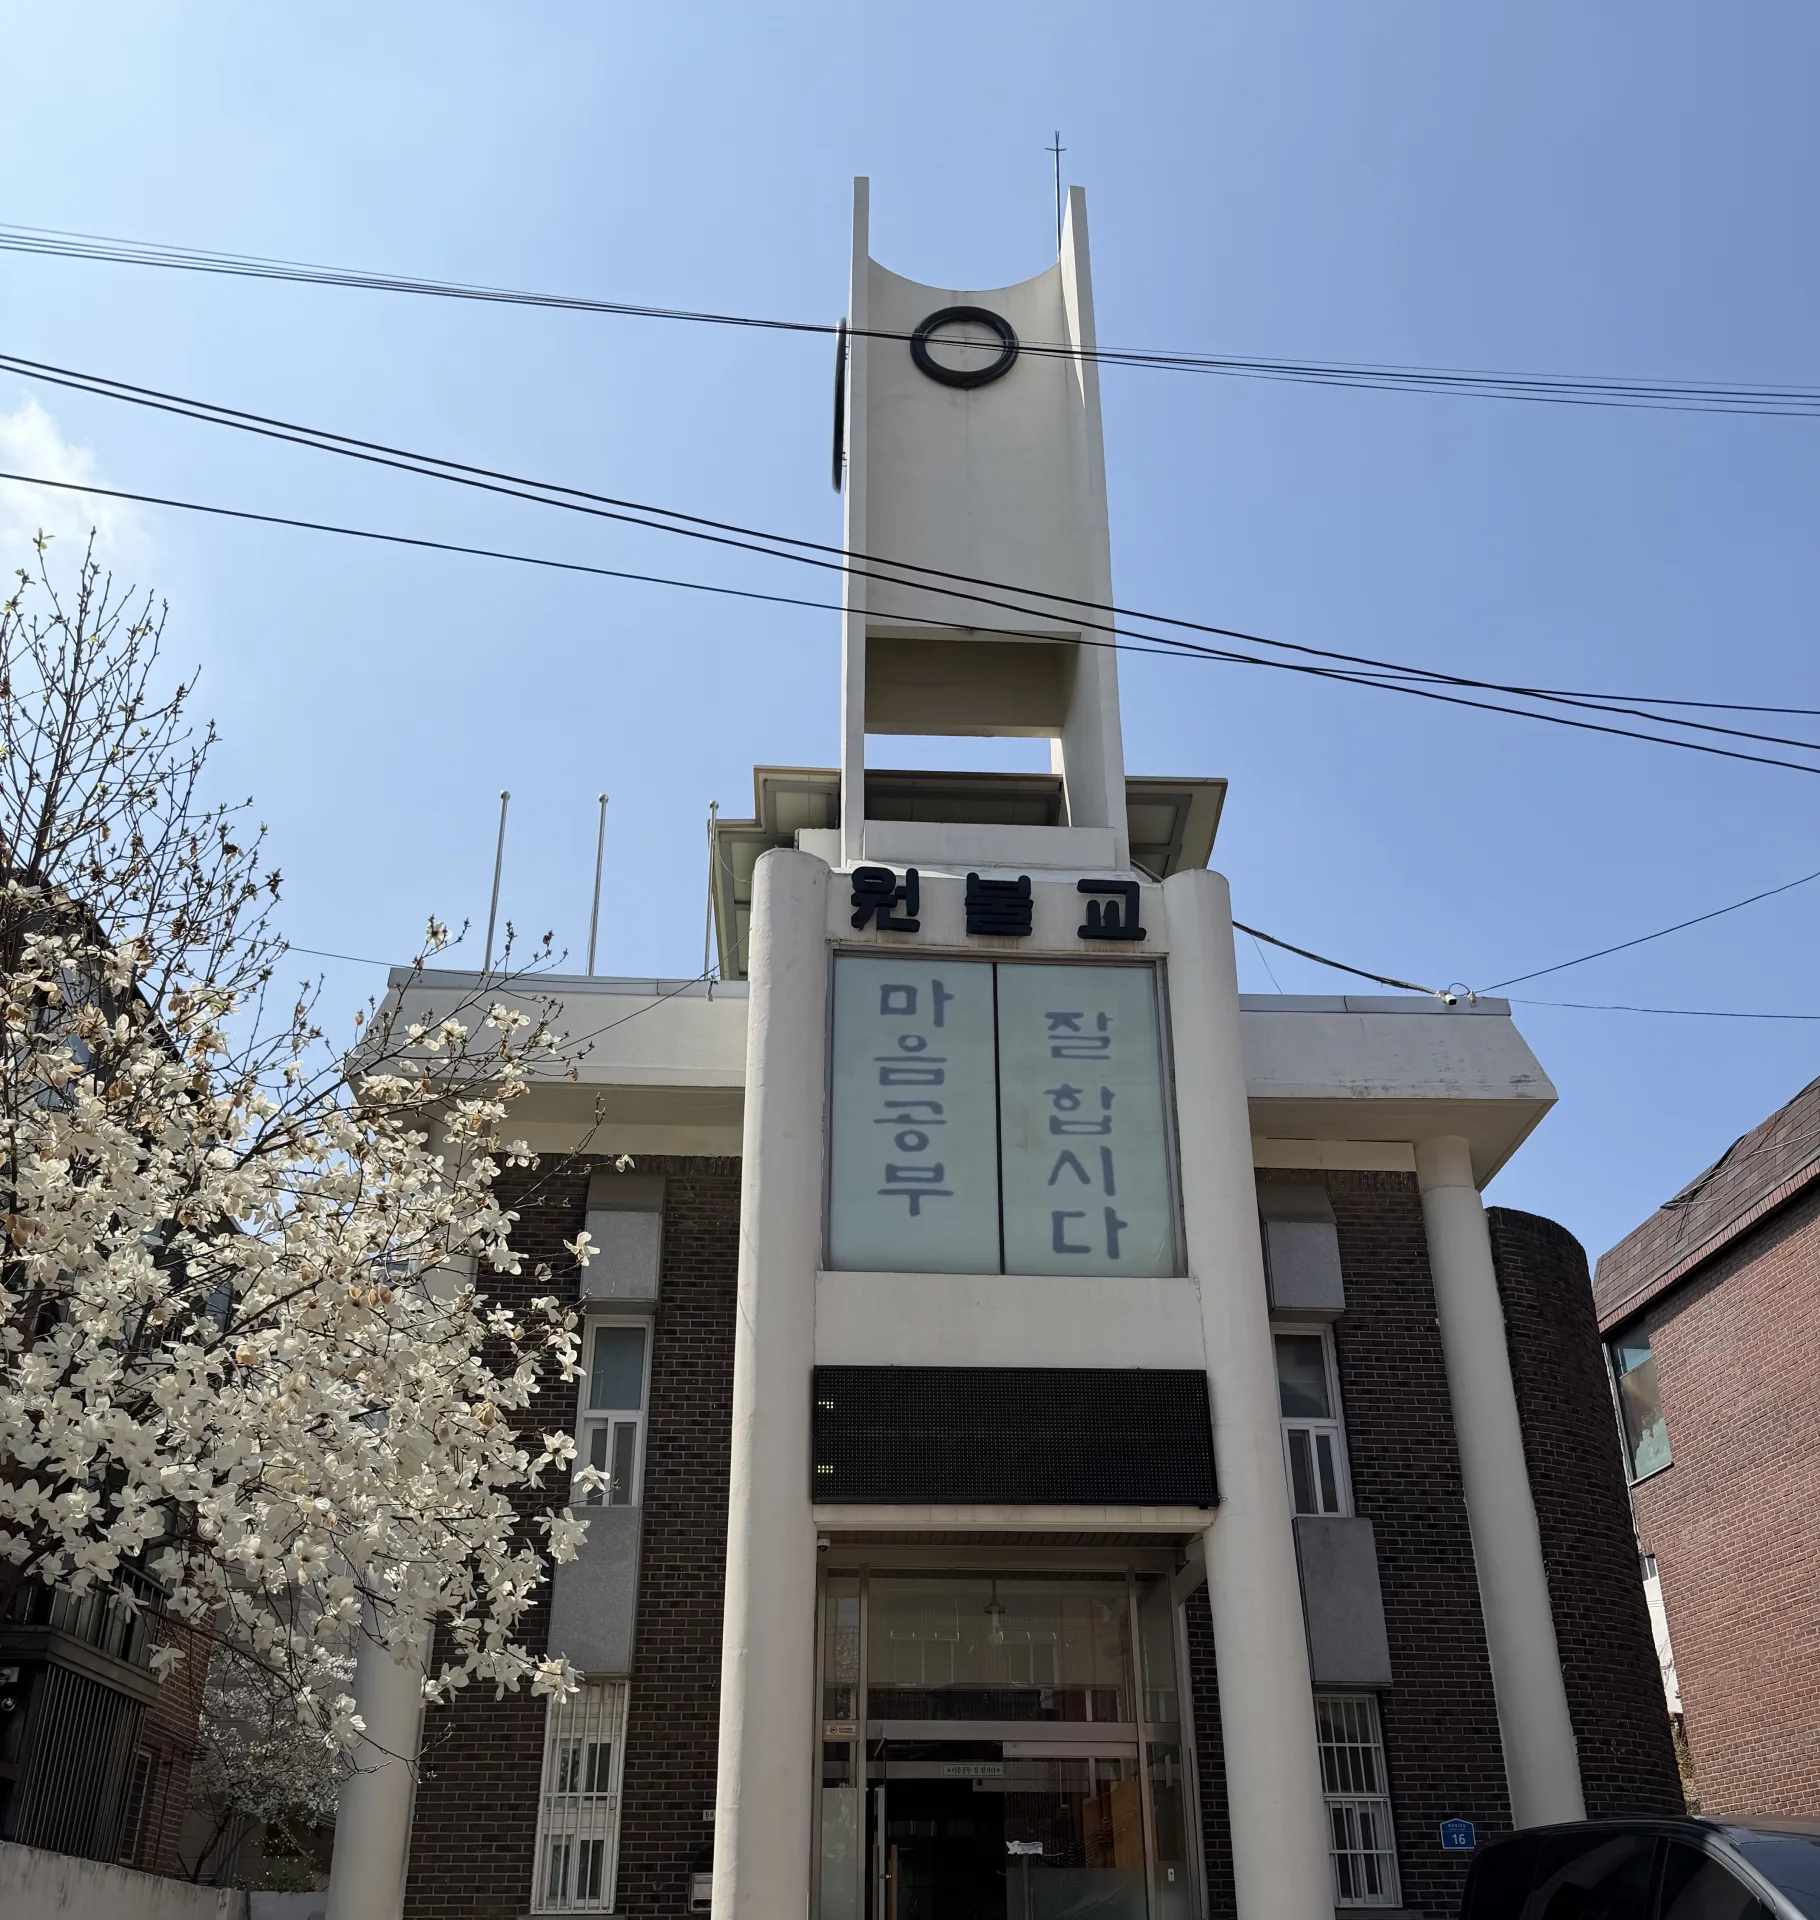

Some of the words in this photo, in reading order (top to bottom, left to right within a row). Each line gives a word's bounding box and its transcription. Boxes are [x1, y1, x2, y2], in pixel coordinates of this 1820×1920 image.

[850, 866, 1147, 941] 원불교
[1044, 1011, 1114, 1060] 잘
[873, 979, 954, 1217] 마음공부
[1043, 1083, 1128, 1260] 합시다
[1452, 1834, 1466, 1845] 16
